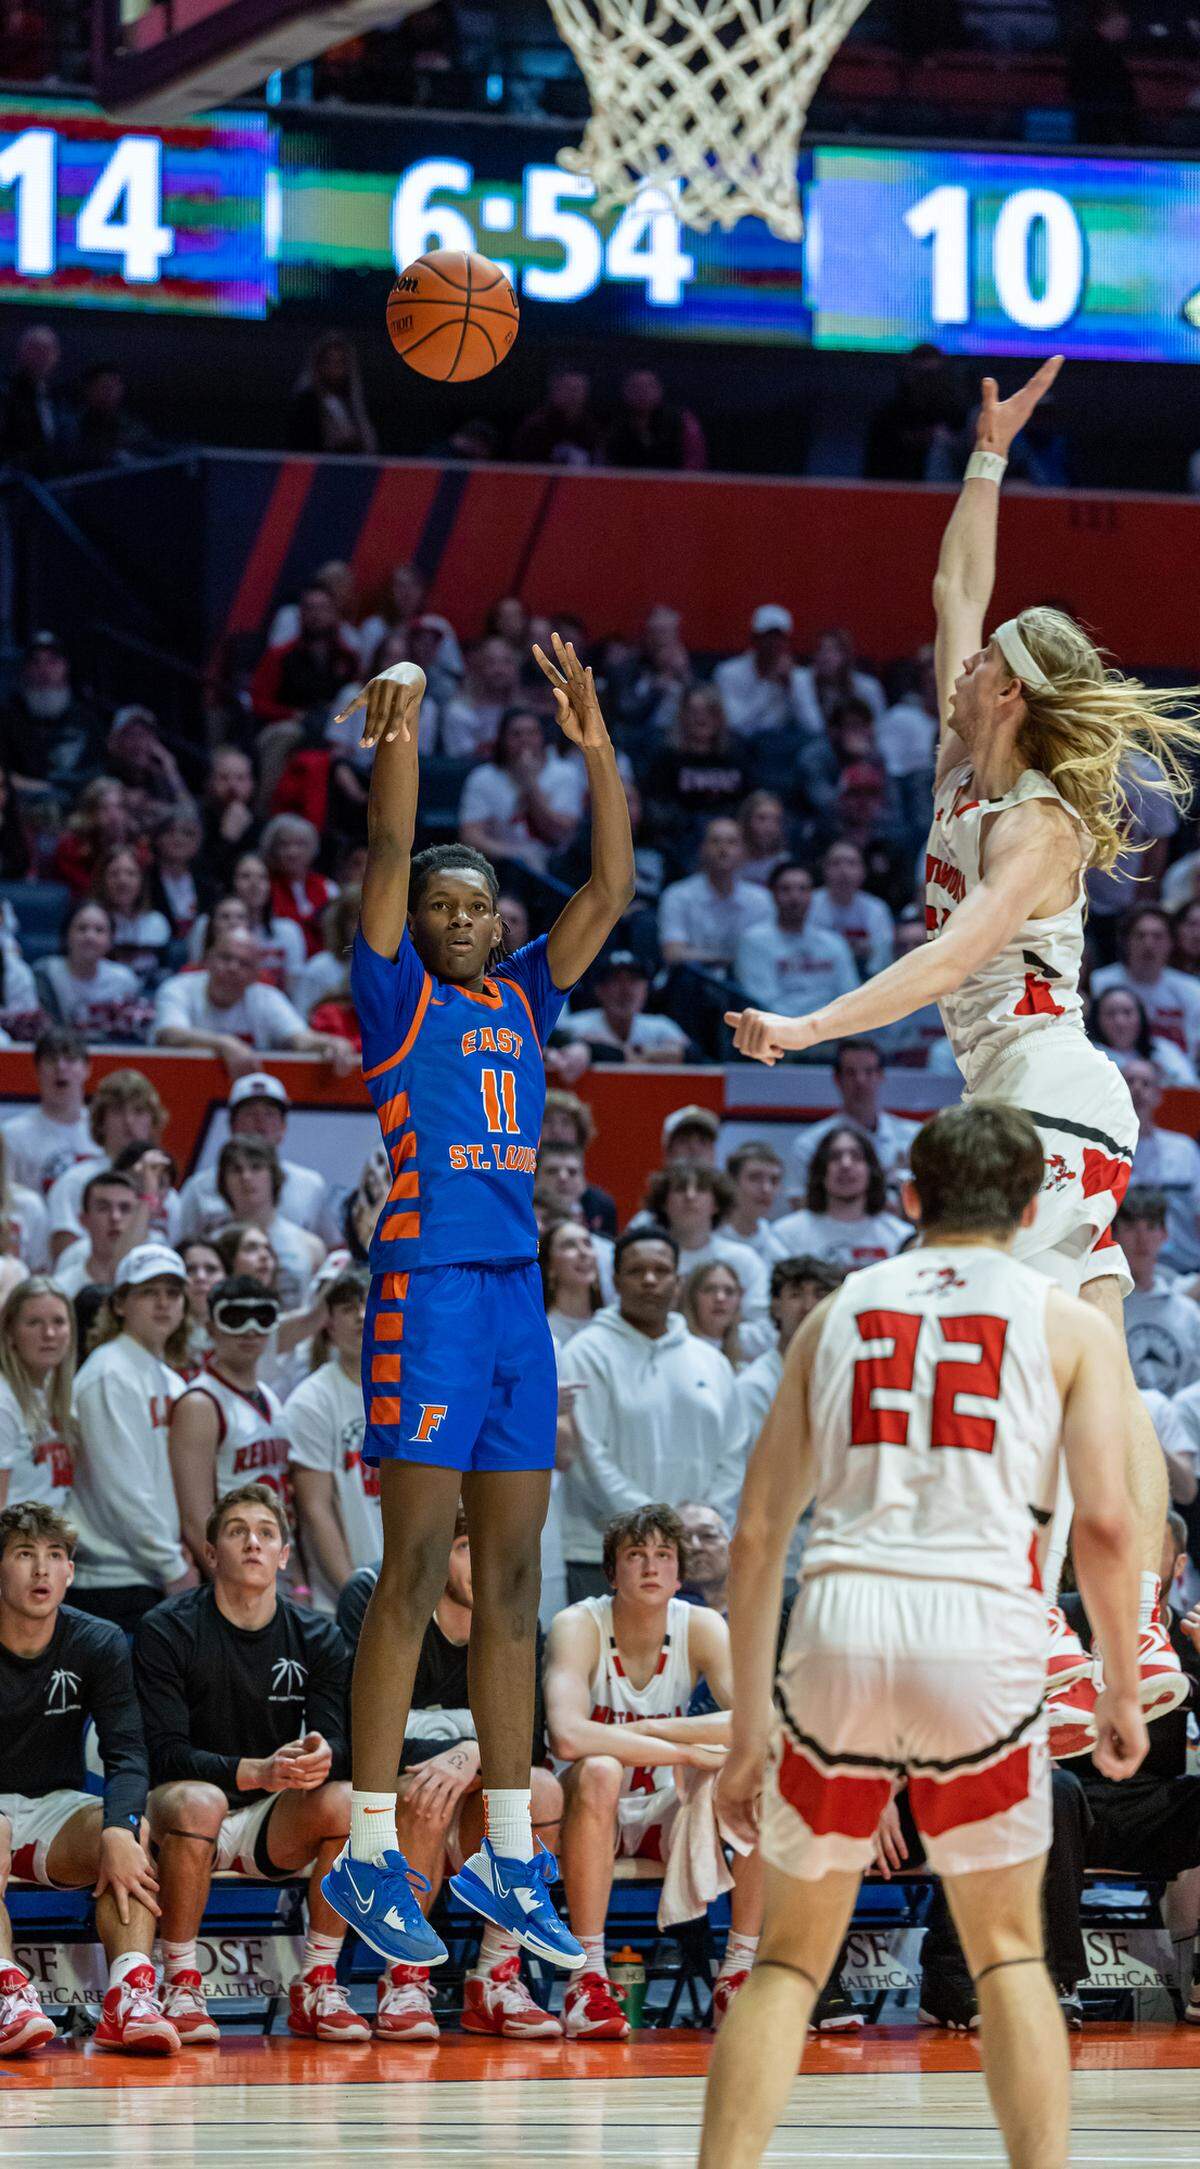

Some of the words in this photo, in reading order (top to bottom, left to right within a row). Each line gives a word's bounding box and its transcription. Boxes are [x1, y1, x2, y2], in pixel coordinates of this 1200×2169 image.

[0, 127, 174, 283] 14
[394, 157, 697, 306] 6:54
[903, 184, 1084, 331] 10
[461, 1027, 523, 1060] EAST
[480, 1068, 520, 1134] 11
[449, 1144, 491, 1169] ST.
[850, 1309, 1008, 1454] 22
[408, 1403, 448, 1442] F
[14, 1946, 57, 1983] SF
[845, 1933, 889, 1968] SF
[1087, 1931, 1129, 1966] SF
[1081, 1970, 1175, 1987] ALTHCARE
